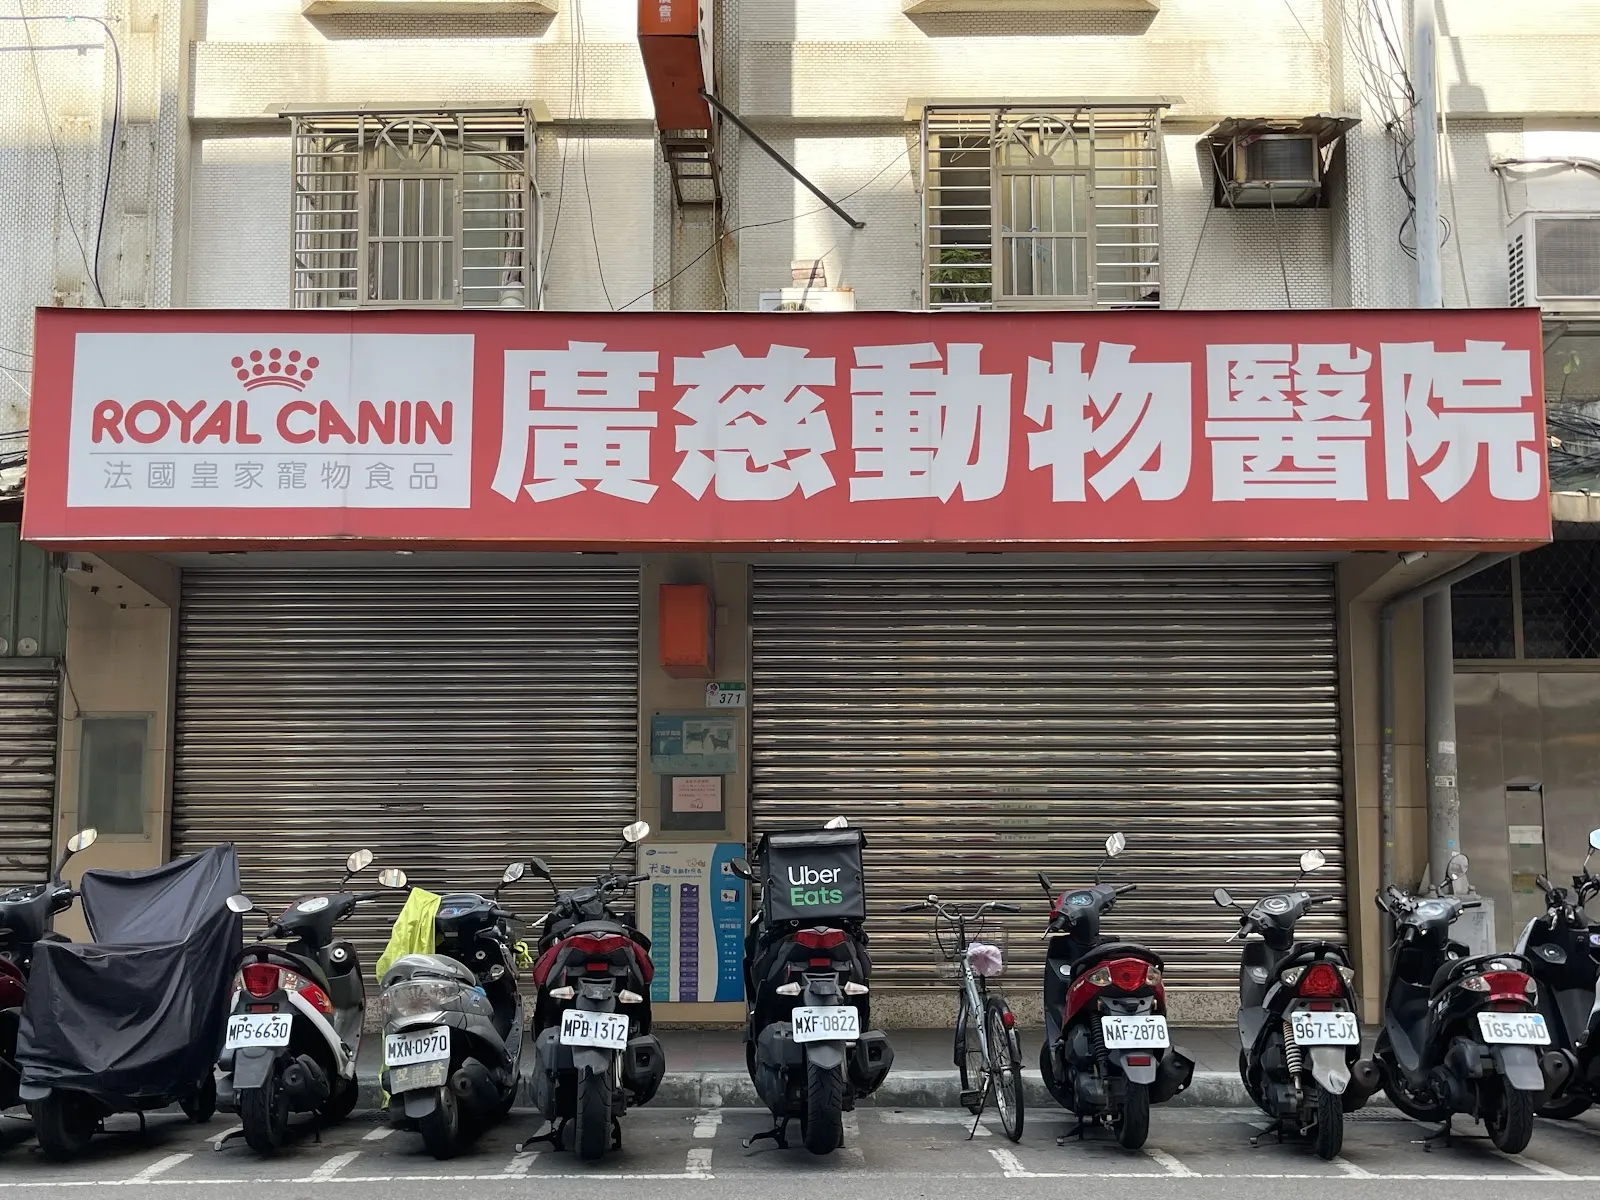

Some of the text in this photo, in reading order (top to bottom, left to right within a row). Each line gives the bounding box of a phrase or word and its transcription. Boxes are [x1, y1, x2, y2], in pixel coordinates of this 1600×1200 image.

[92, 399, 453, 445] ROYAL CANIN
[490, 339, 1543, 505] 廣慈動物醫院
[103, 460, 439, 491] 法國皇家寵物食品
[719, 693, 741, 704] 371
[787, 866, 841, 886] Uber
[790, 887, 843, 906] Eats
